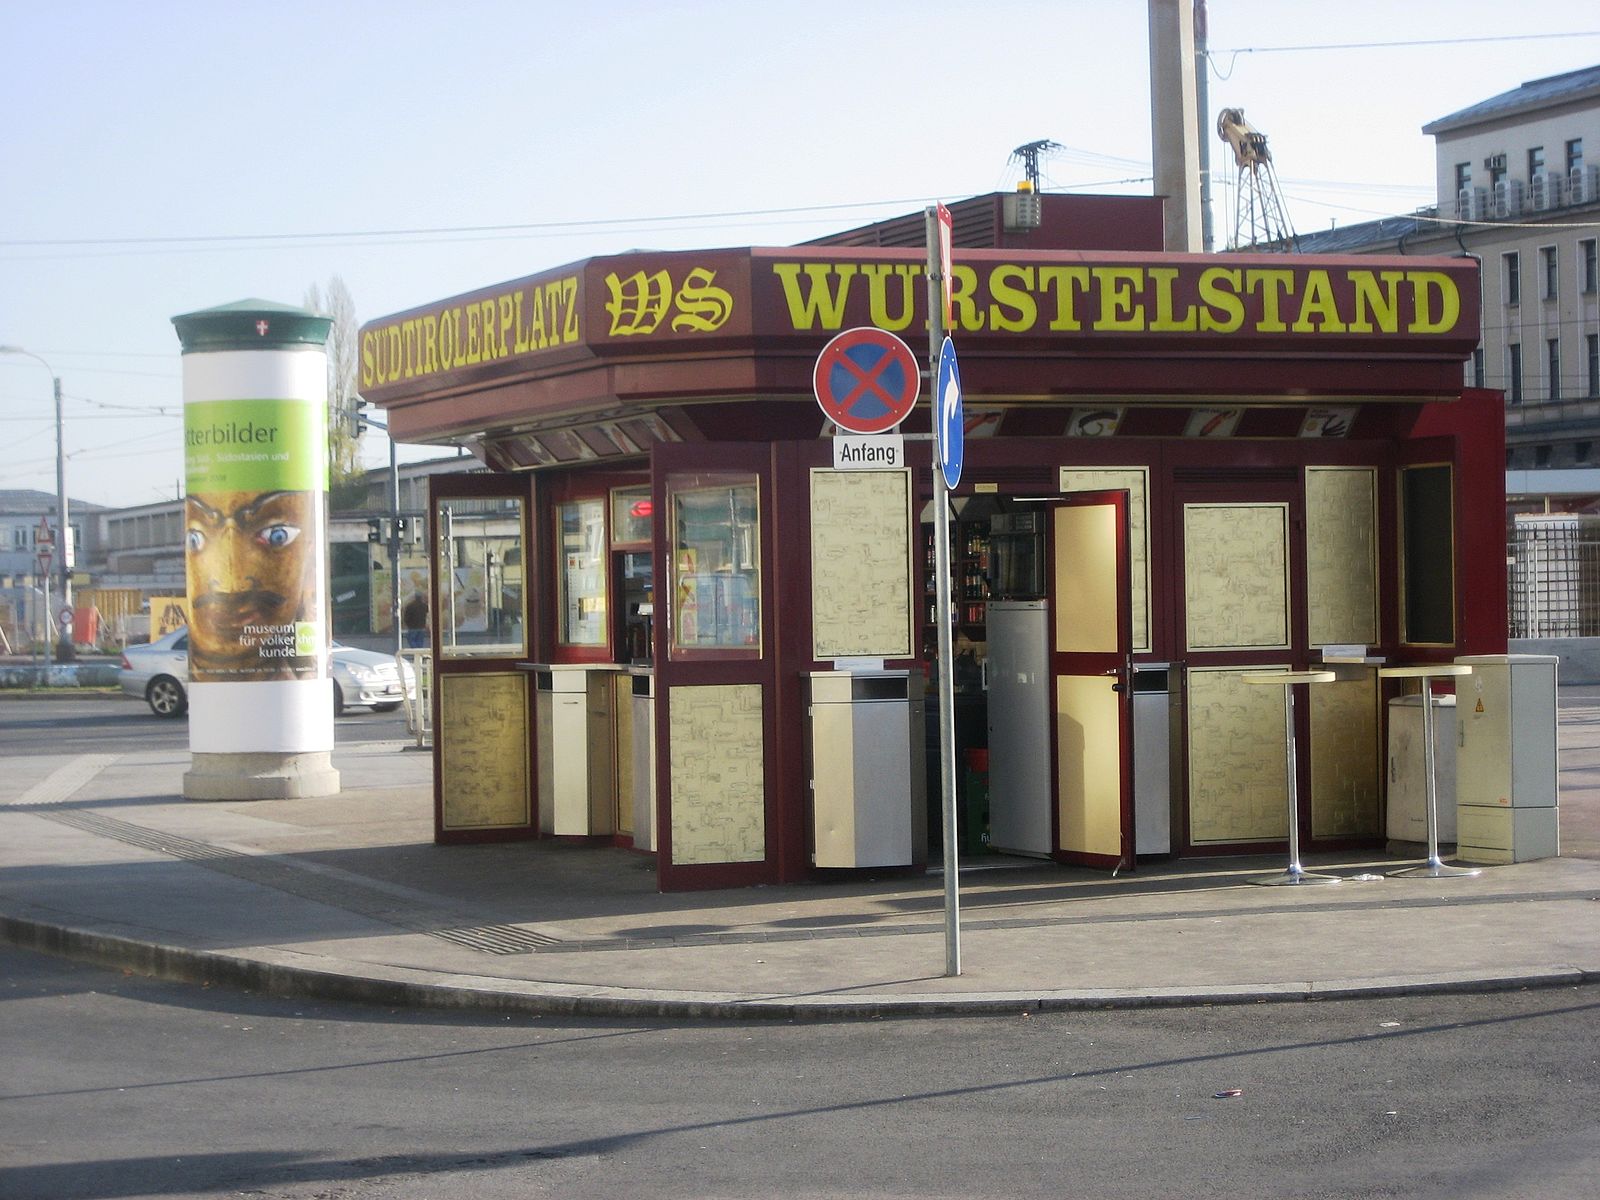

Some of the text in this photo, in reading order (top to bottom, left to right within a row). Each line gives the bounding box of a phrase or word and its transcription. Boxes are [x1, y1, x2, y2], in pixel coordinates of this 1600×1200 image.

[604, 266, 735, 337] WS
[772, 263, 1462, 335] WURSTELSTAND
[362, 276, 579, 388] SÜDTIROLERPLATZ
[185, 421, 278, 447] tterbilder
[841, 442, 896, 466] Anfang
[239, 634, 257, 647] für
[243, 622, 295, 635] museum
[258, 646, 296, 658] kunde
